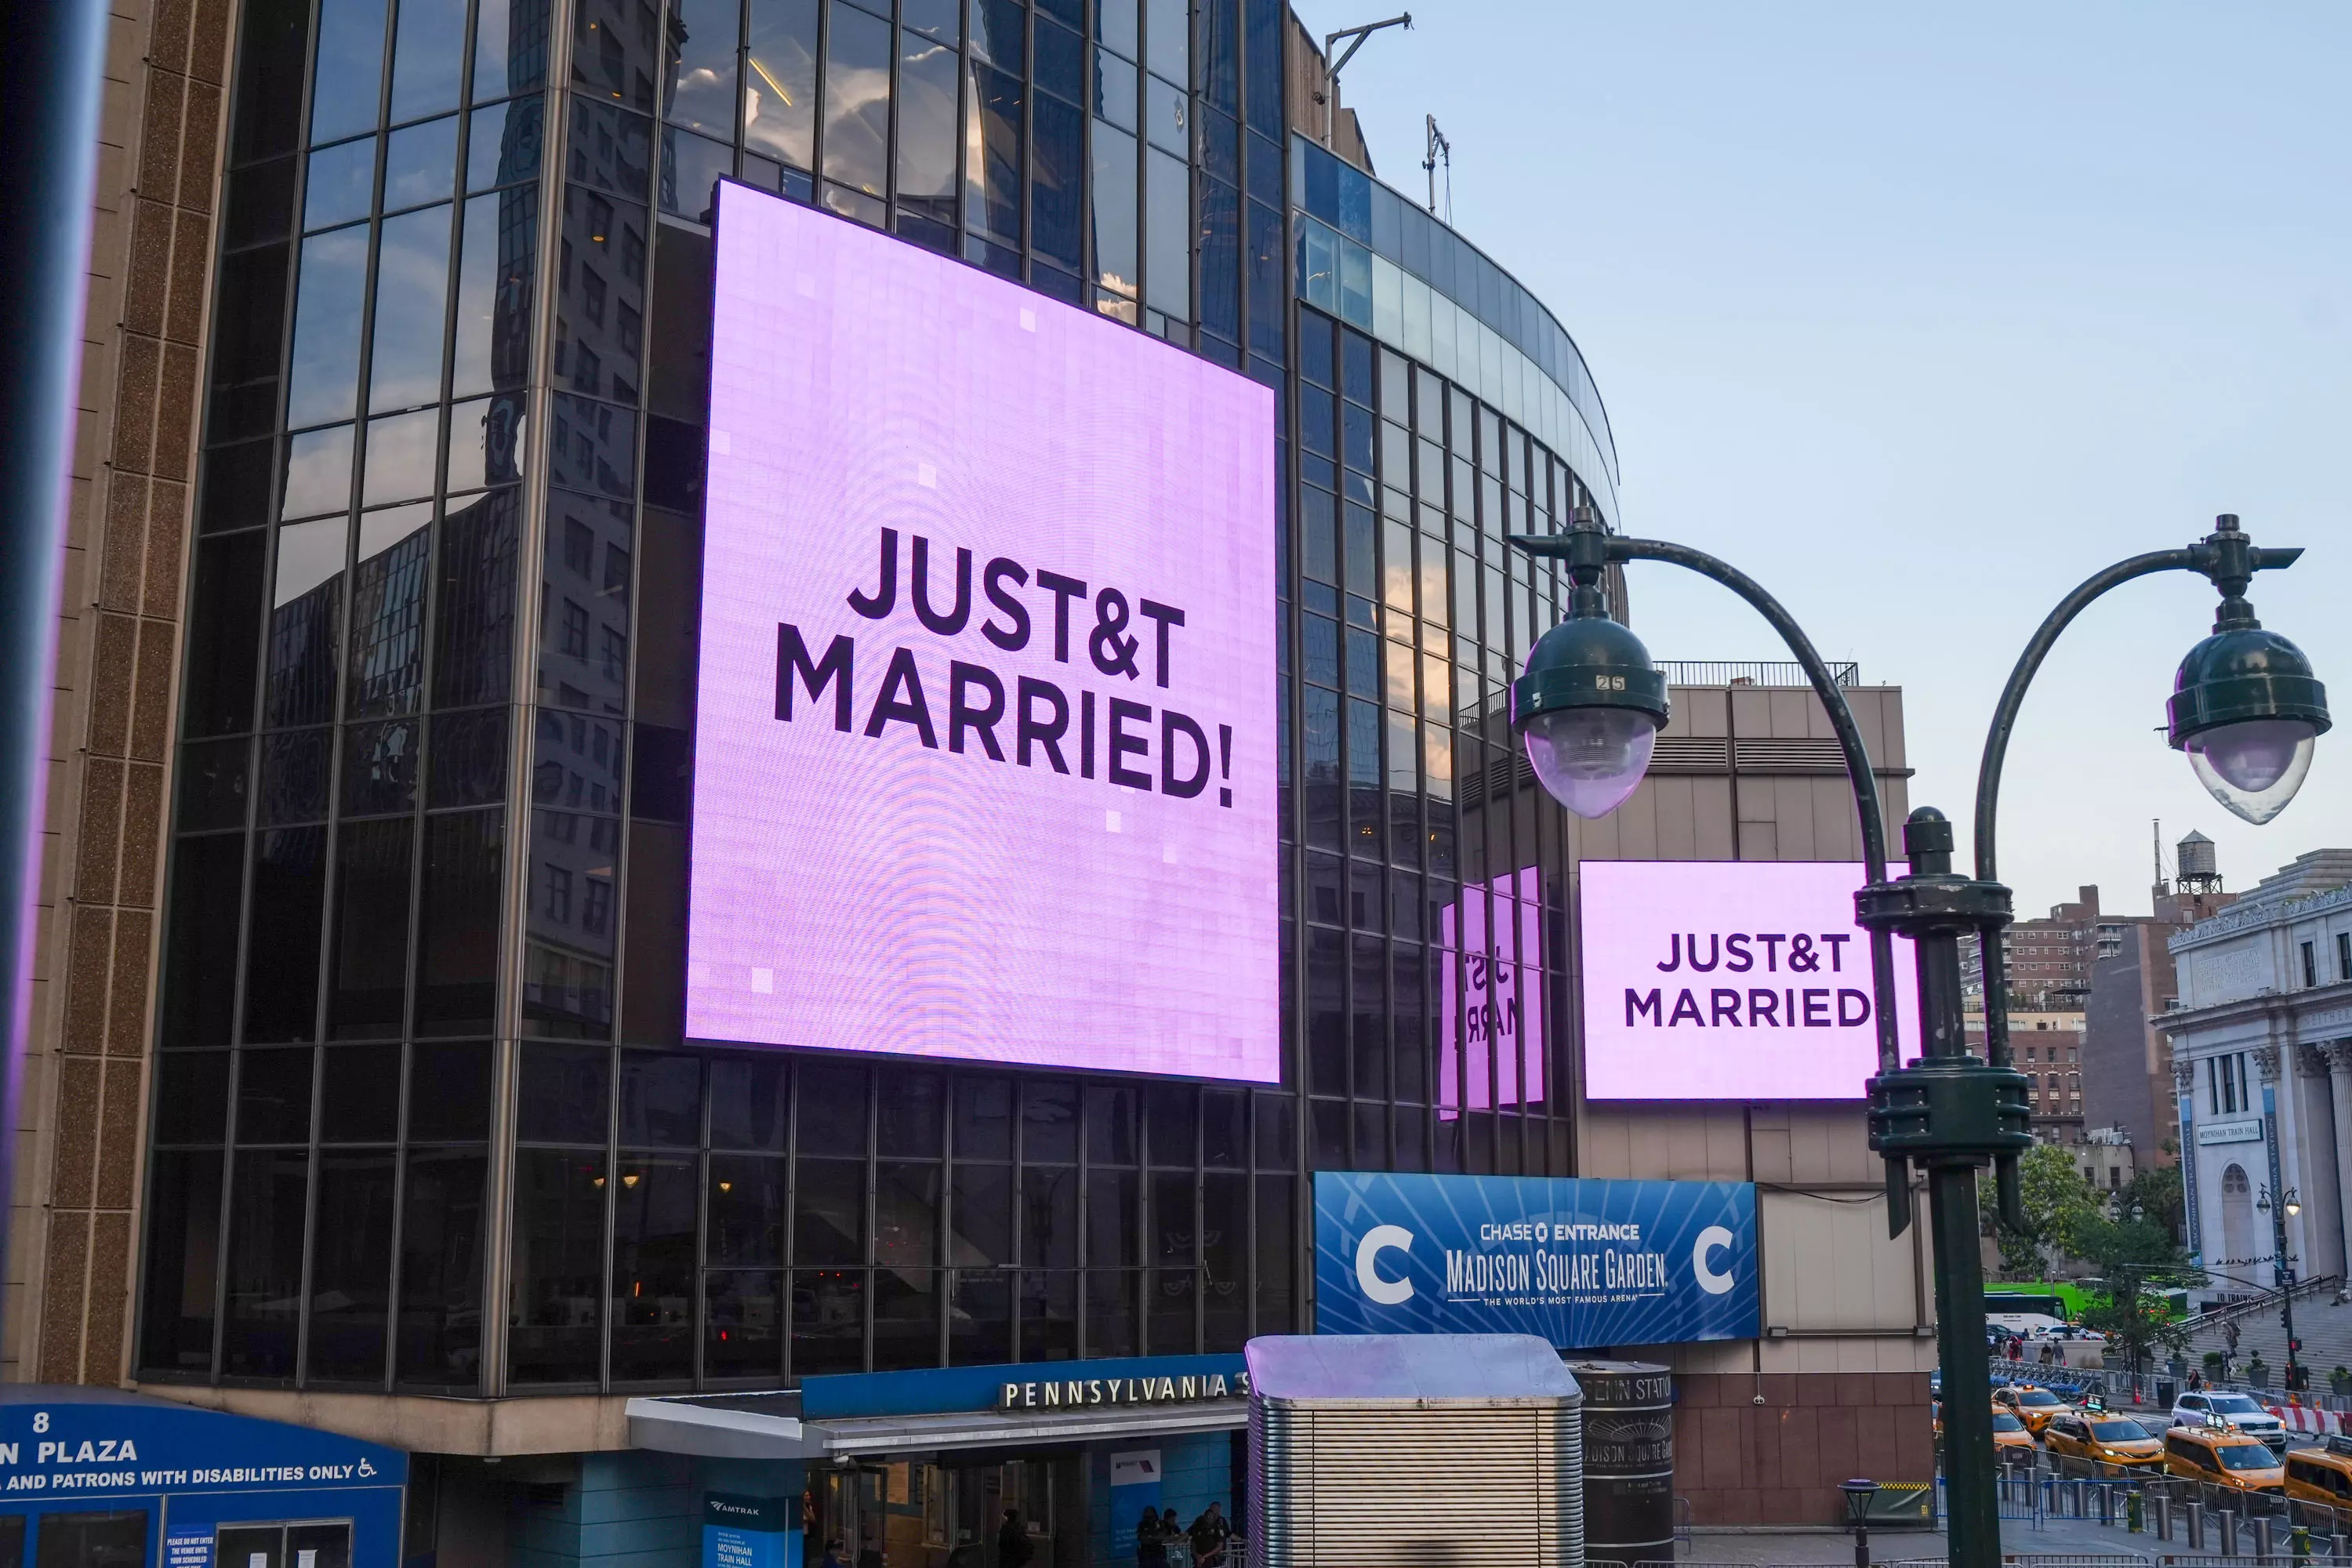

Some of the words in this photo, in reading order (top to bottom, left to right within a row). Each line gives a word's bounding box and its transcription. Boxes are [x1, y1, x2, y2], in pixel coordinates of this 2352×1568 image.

[846, 526, 1185, 689] JUST&T
[1597, 676, 1624, 690] 25
[775, 622, 1232, 809] MARRIED!
[1656, 933, 1851, 973] JUST&T
[1624, 988, 1871, 1028] MARRIED
[2200, 1129, 2227, 1138] MOYNIHAN
[2227, 1127, 2244, 1136] TRAIN
[1480, 1224, 1532, 1240] CHASE
[1555, 1225, 1639, 1240] ENTRANCE
[1356, 1225, 1414, 1305] C
[1693, 1225, 1736, 1295] C
[1446, 1249, 1530, 1292] MADISON
[1536, 1248, 1600, 1294] SQUARE
[1505, 1297, 1544, 1305] WORLD'S
[1548, 1296, 1572, 1305] MOST
[1574, 1294, 1608, 1304] FAMOUS
[2216, 1293, 2225, 1301] TO
[1006, 1374, 1227, 1407] PENNSYLVANIA
[1636, 1376, 1671, 1399] STATIO
[33, 1412, 49, 1433] 8
[38, 1439, 137, 1464] PLAZA
[1584, 1445, 1624, 1462] ADISON
[6, 1474, 46, 1490] AND
[53, 1472, 136, 1488] PATRONS
[141, 1470, 187, 1486] WITH
[192, 1467, 303, 1484] DISABILITIES
[309, 1465, 354, 1480] ONLY
[722, 1504, 760, 1515] AMTRAK
[167, 1537, 183, 1546] PLEASE
[717, 1543, 753, 1556] MOYNIHAN
[183, 1555, 207, 1564] SCHEDULED
[717, 1553, 735, 1564] TRAIN
[736, 1555, 753, 1566] HALL
